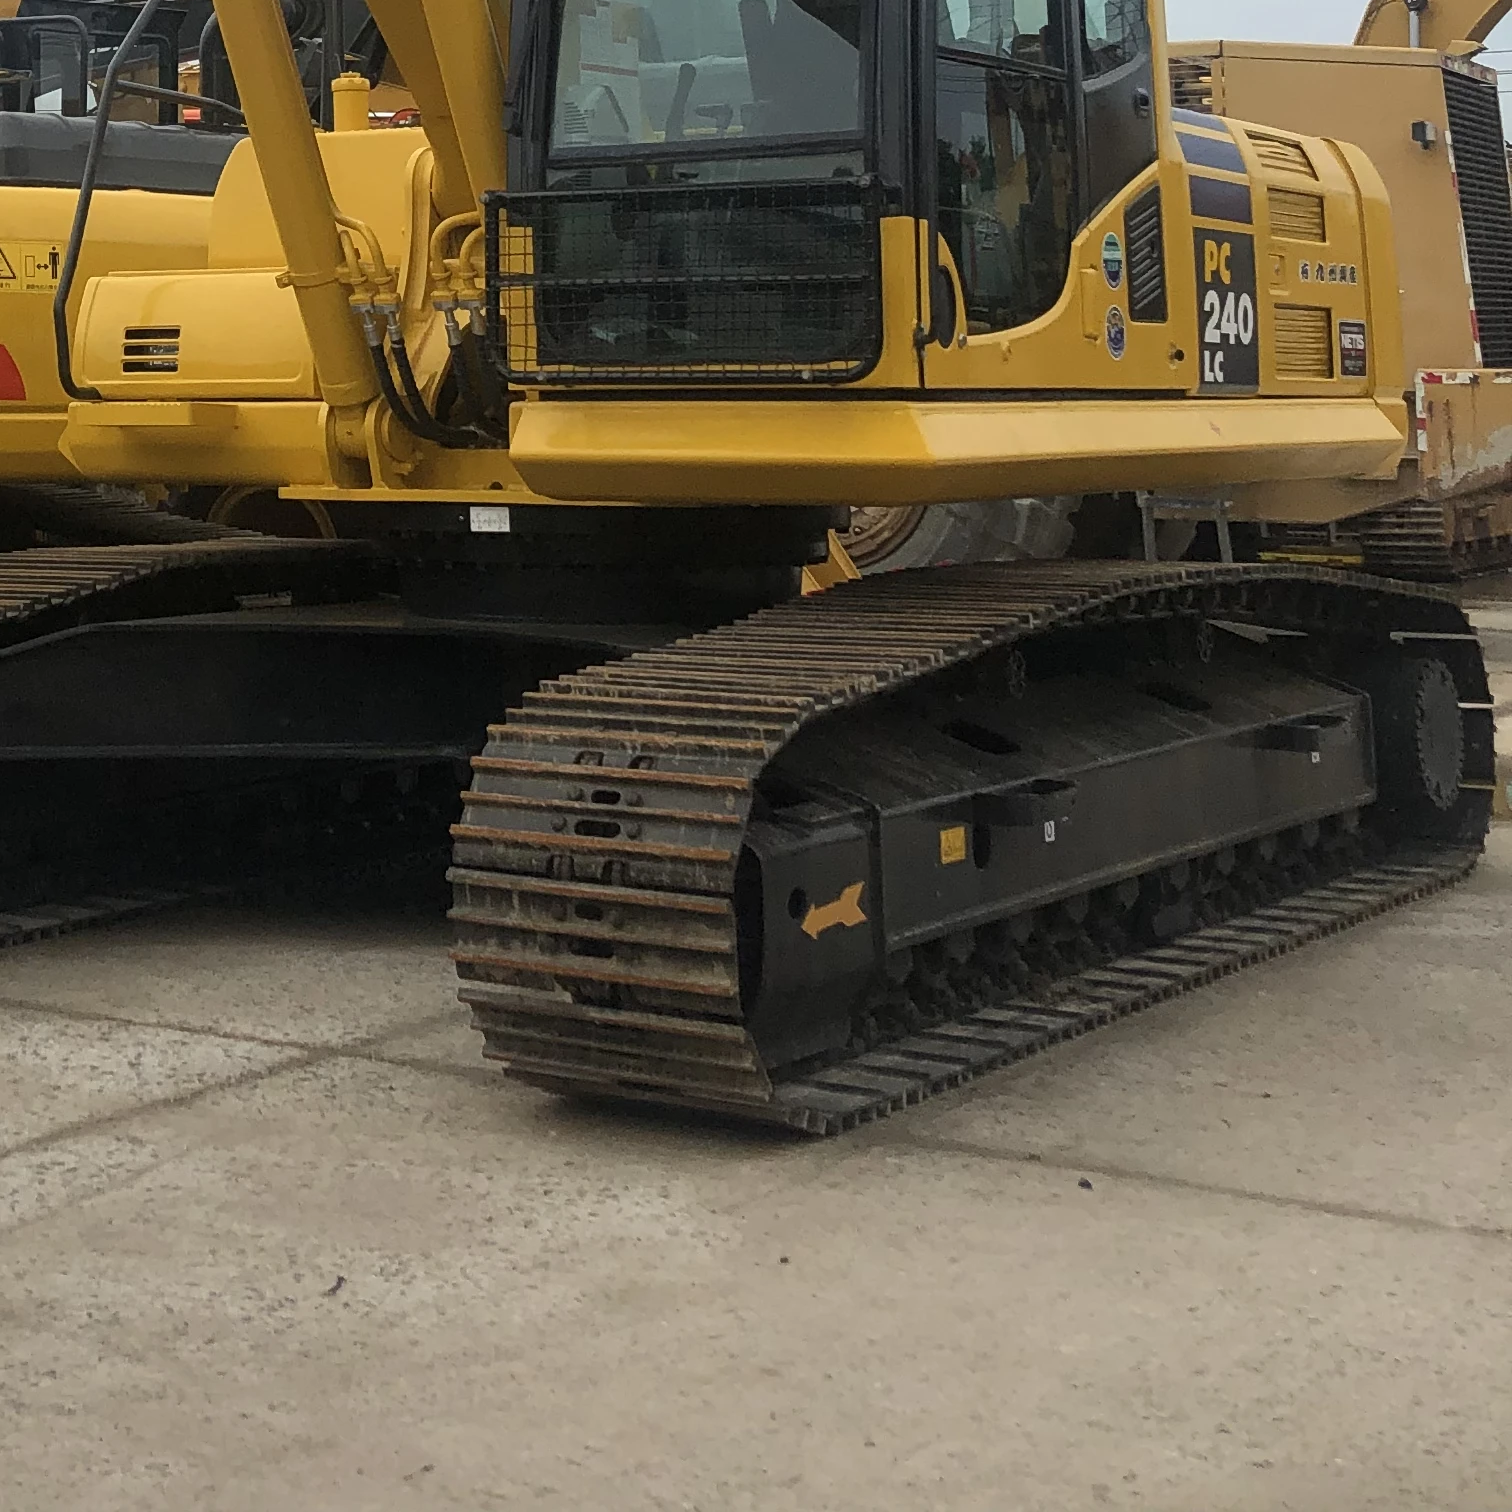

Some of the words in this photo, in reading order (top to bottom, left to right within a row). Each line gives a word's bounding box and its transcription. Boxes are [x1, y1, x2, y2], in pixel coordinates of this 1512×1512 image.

[1204, 239, 1231, 285] PC
[1204, 289, 1254, 345] 240
[1204, 350, 1224, 383] LC
